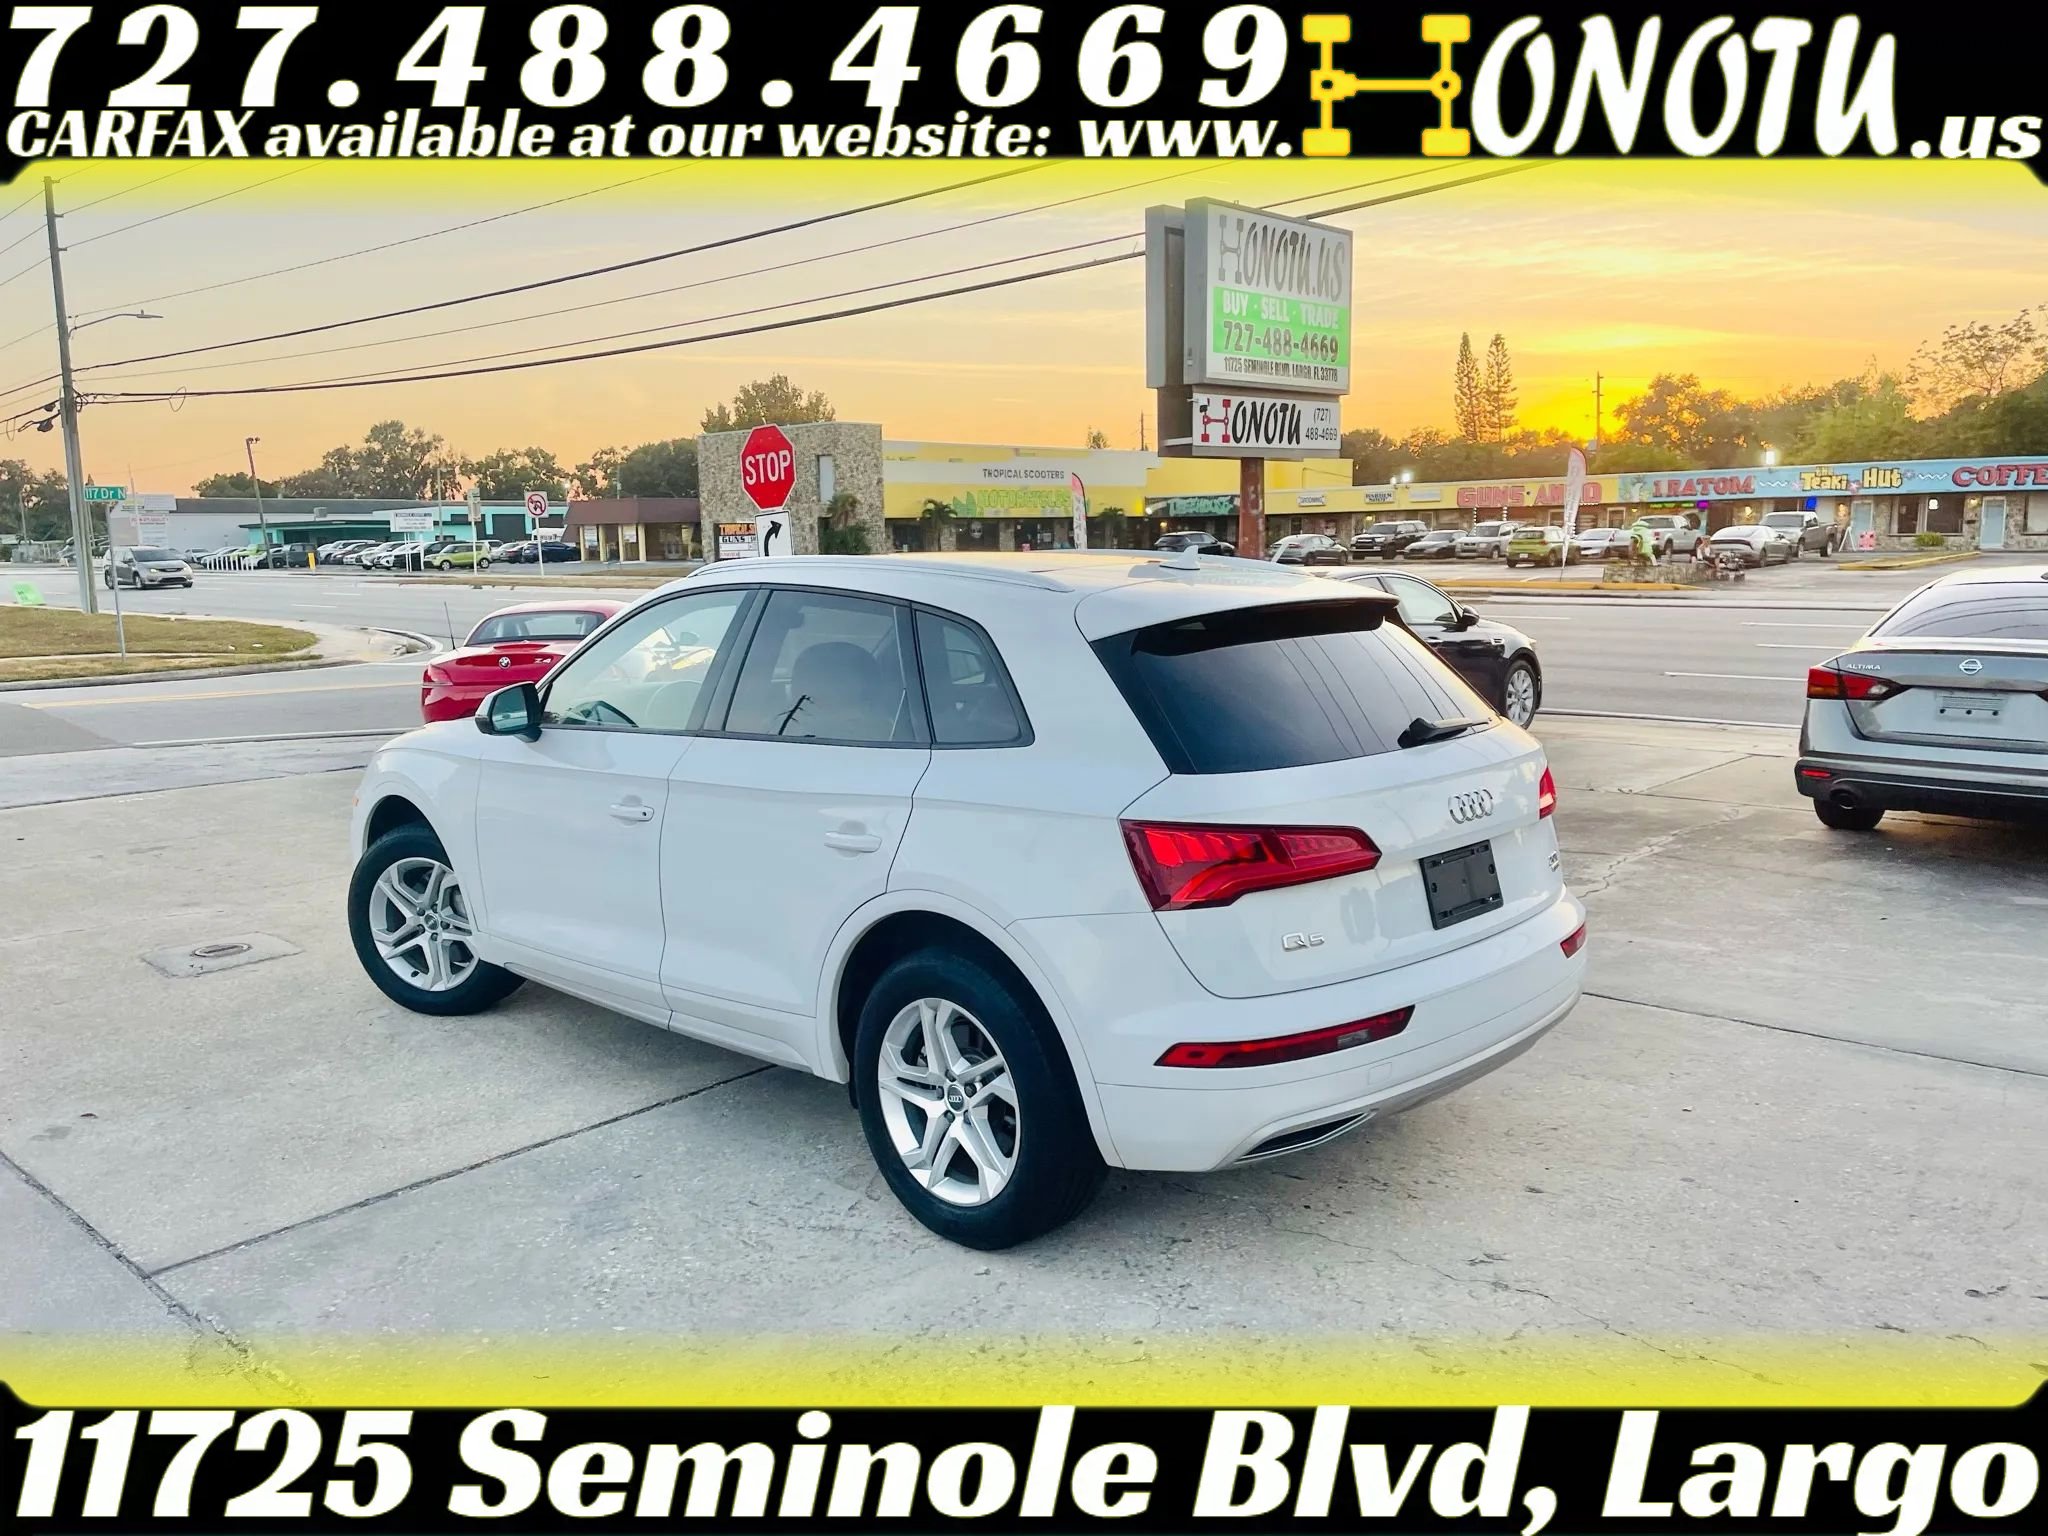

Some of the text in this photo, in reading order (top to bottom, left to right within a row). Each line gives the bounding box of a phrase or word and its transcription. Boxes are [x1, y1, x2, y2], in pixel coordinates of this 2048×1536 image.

[1222, 290, 1339, 330] BUY SELL TRADE
[1222, 320, 1339, 363] 727-488-4669
[1313, 407, 1332, 424] (727)
[1305, 427, 1338, 442] 488-4669
[745, 450, 791, 486] STOP
[982, 468, 1065, 480] TROPICAL SCOOTERS
[101, 488, 114, 499] Dr
[118, 488, 126, 499] N
[1456, 486, 1526, 508] GUNS
[1281, 931, 1325, 952] Q5
